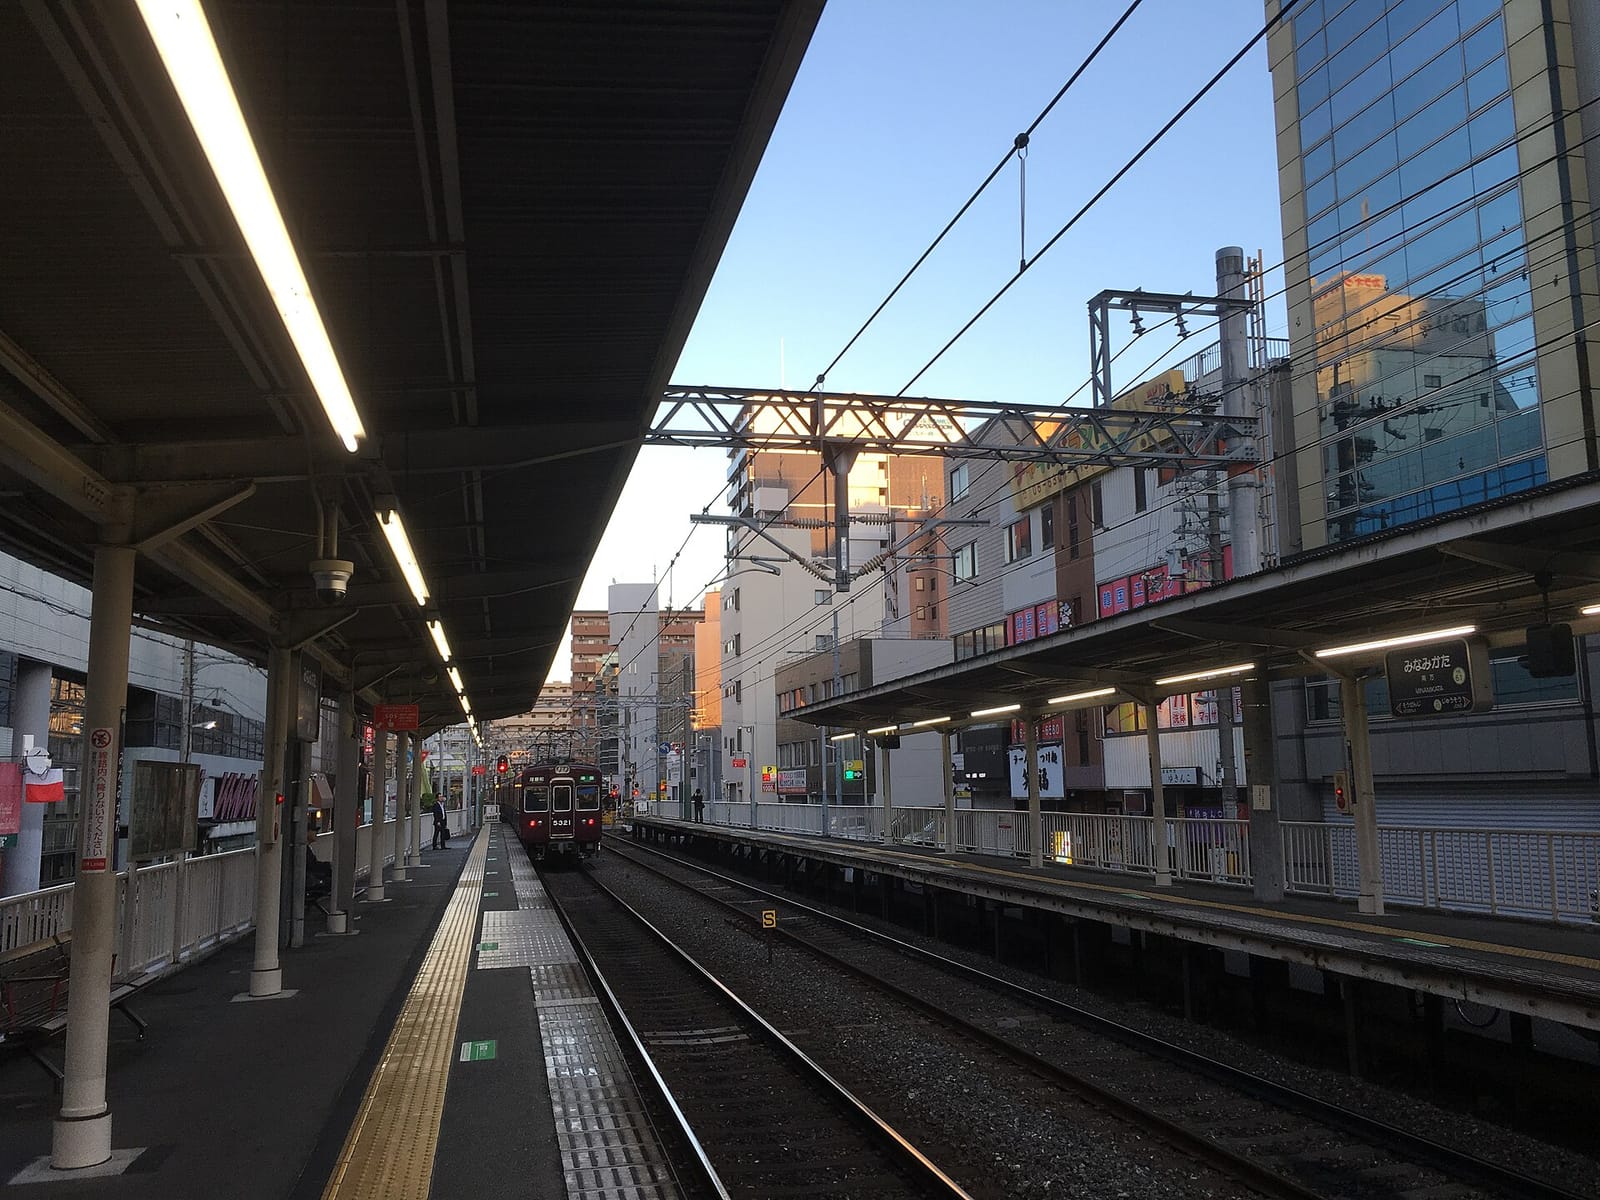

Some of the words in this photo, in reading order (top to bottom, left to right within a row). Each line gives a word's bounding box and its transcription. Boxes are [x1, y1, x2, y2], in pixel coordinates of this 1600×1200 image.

[1403, 655, 1451, 673] みなみかた
[764, 912, 775, 926] S
